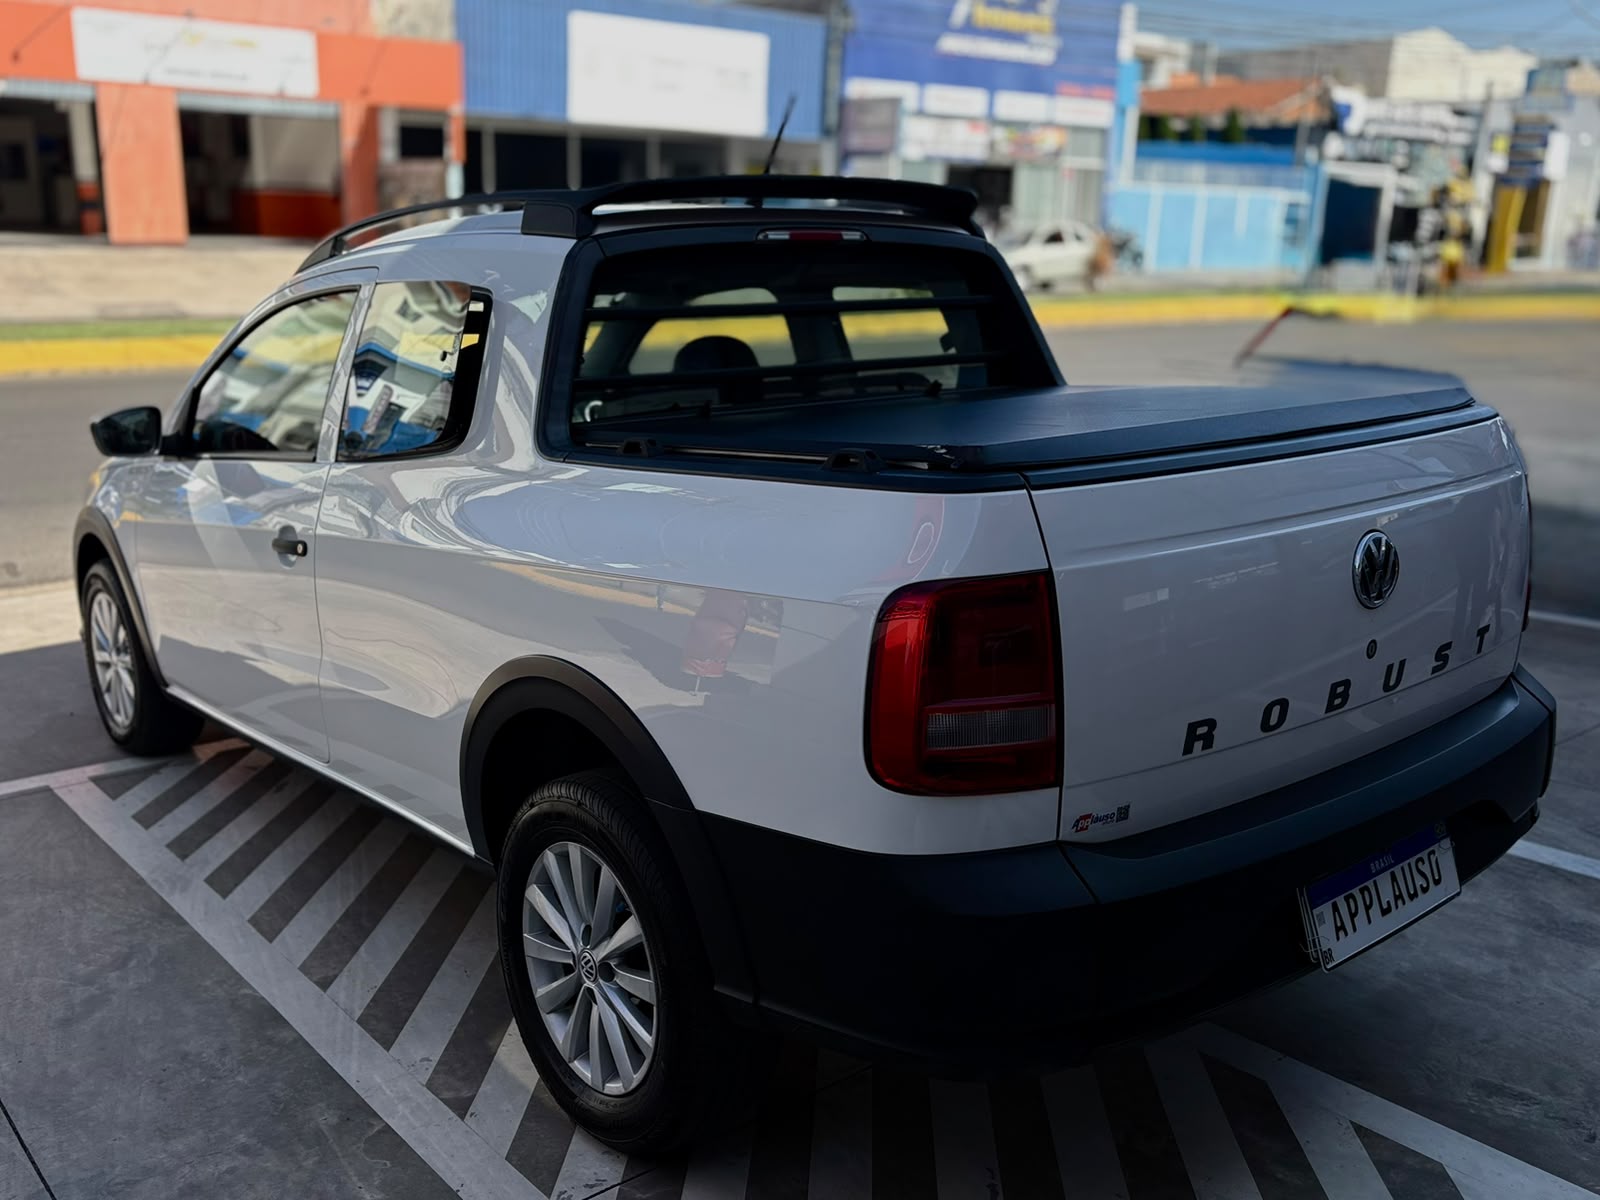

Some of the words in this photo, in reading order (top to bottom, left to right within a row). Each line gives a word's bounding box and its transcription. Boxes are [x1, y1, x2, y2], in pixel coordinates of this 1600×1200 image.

[1182, 624, 1491, 756] ROBUST
[1370, 854, 1394, 873] BRASIL
[1331, 849, 1443, 942] APPLAUSO
[1323, 948, 1335, 965] BR
